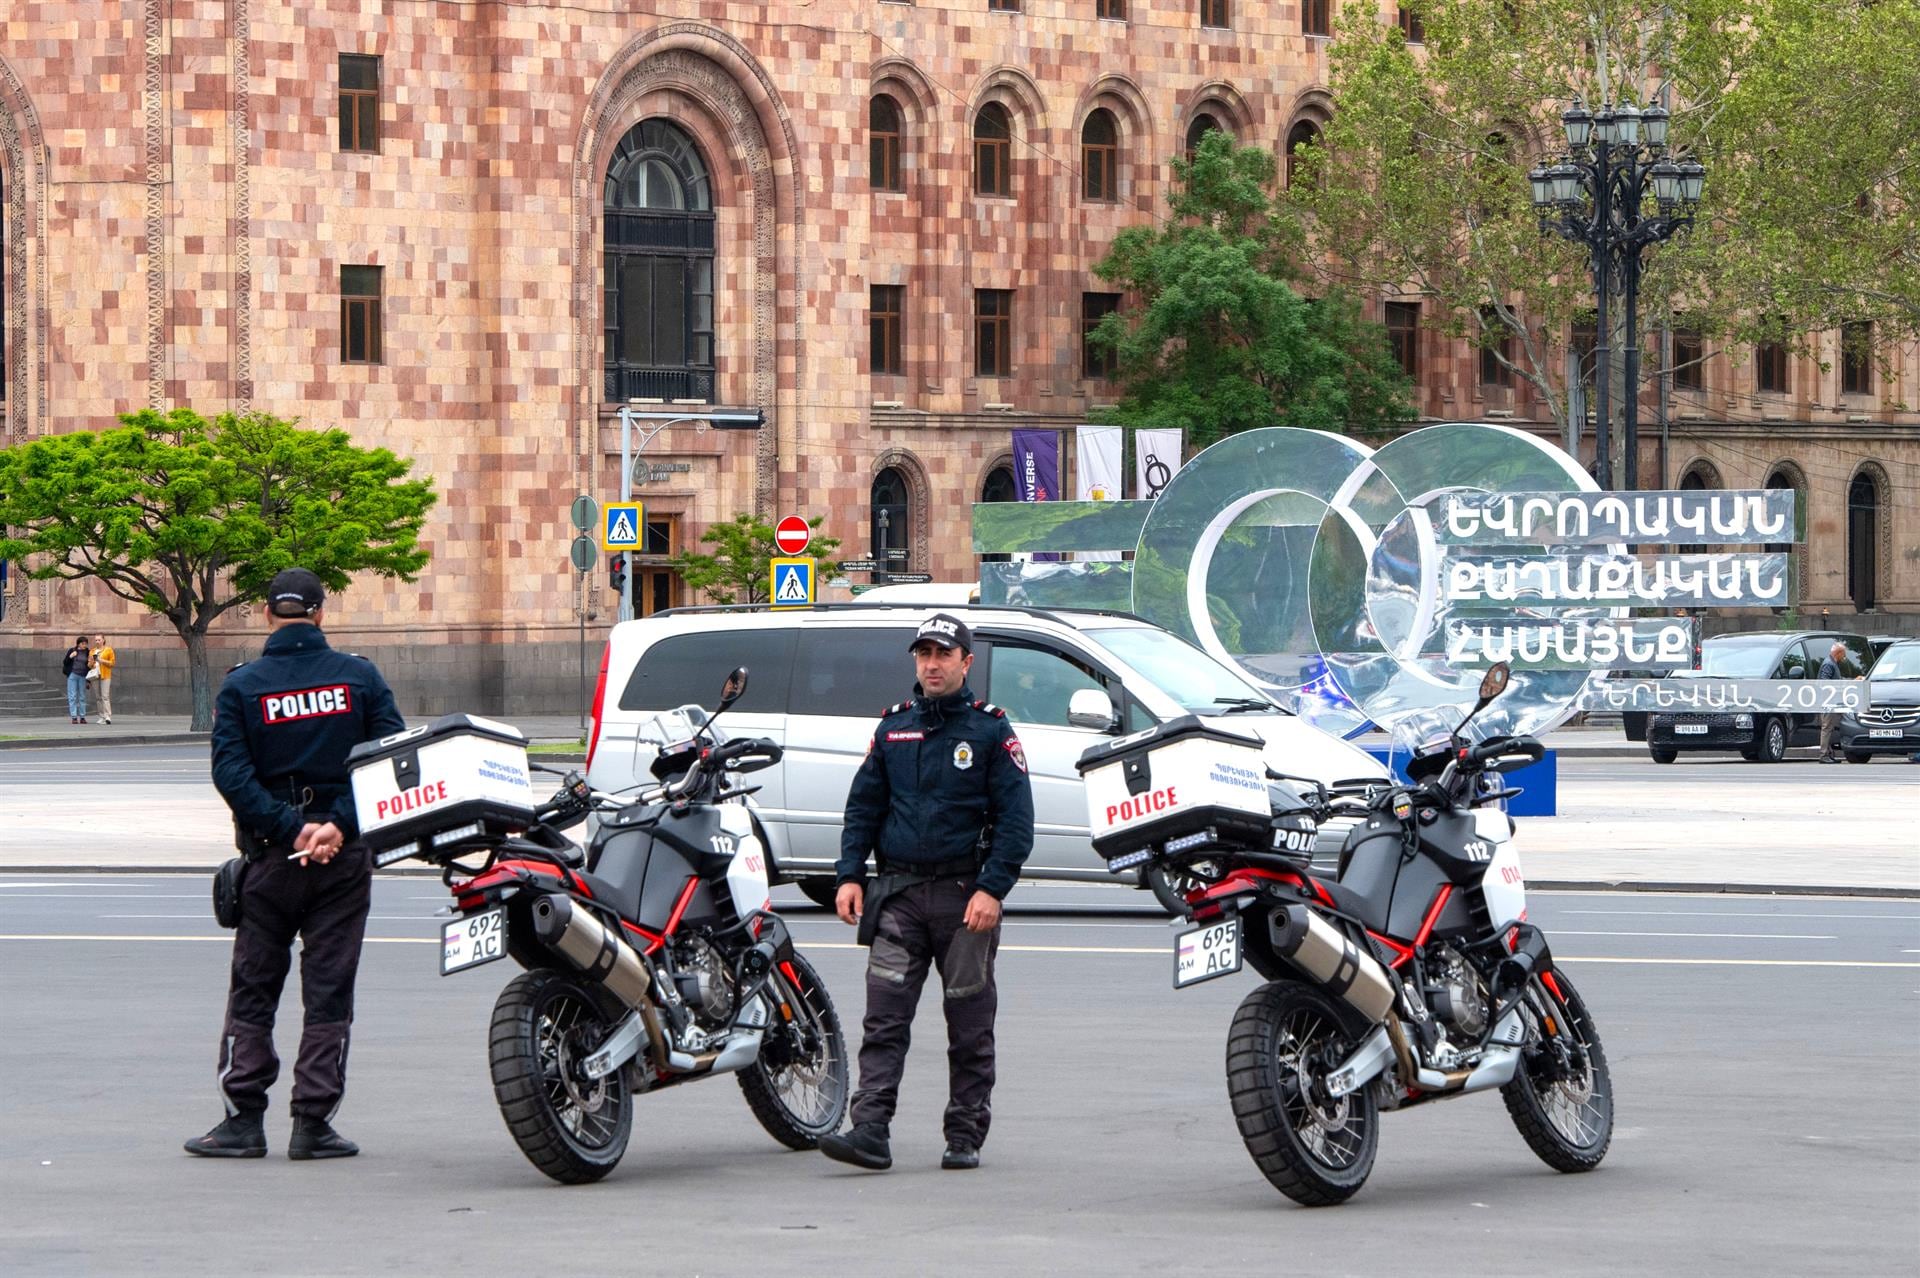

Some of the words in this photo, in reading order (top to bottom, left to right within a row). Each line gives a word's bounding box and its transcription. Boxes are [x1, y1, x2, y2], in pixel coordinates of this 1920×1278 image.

[1026, 451, 1036, 501] NVERSE
[1447, 496, 1785, 537] ԵՎՐՈՊԱԿԱՆ
[1447, 559, 1783, 601] ՔԱՂԱՔԱԿԱՆ
[916, 619, 959, 638] POLICE
[1448, 625, 1688, 664] ՀԱՄԱՅՆՔ
[266, 688, 347, 720] POLICE
[1602, 683, 1753, 708] ԵՐԵՎԱՆ
[1776, 684, 1860, 709] 2026
[376, 780, 448, 820] POLICE
[1106, 786, 1178, 826] POLICE
[710, 835, 735, 854] 112
[1463, 842, 1491, 862] 112
[468, 912, 501, 938] 692
[1202, 923, 1236, 950] 695
[472, 935, 497, 960] AC
[1206, 948, 1232, 973] AC
[1179, 958, 1195, 972] AM
